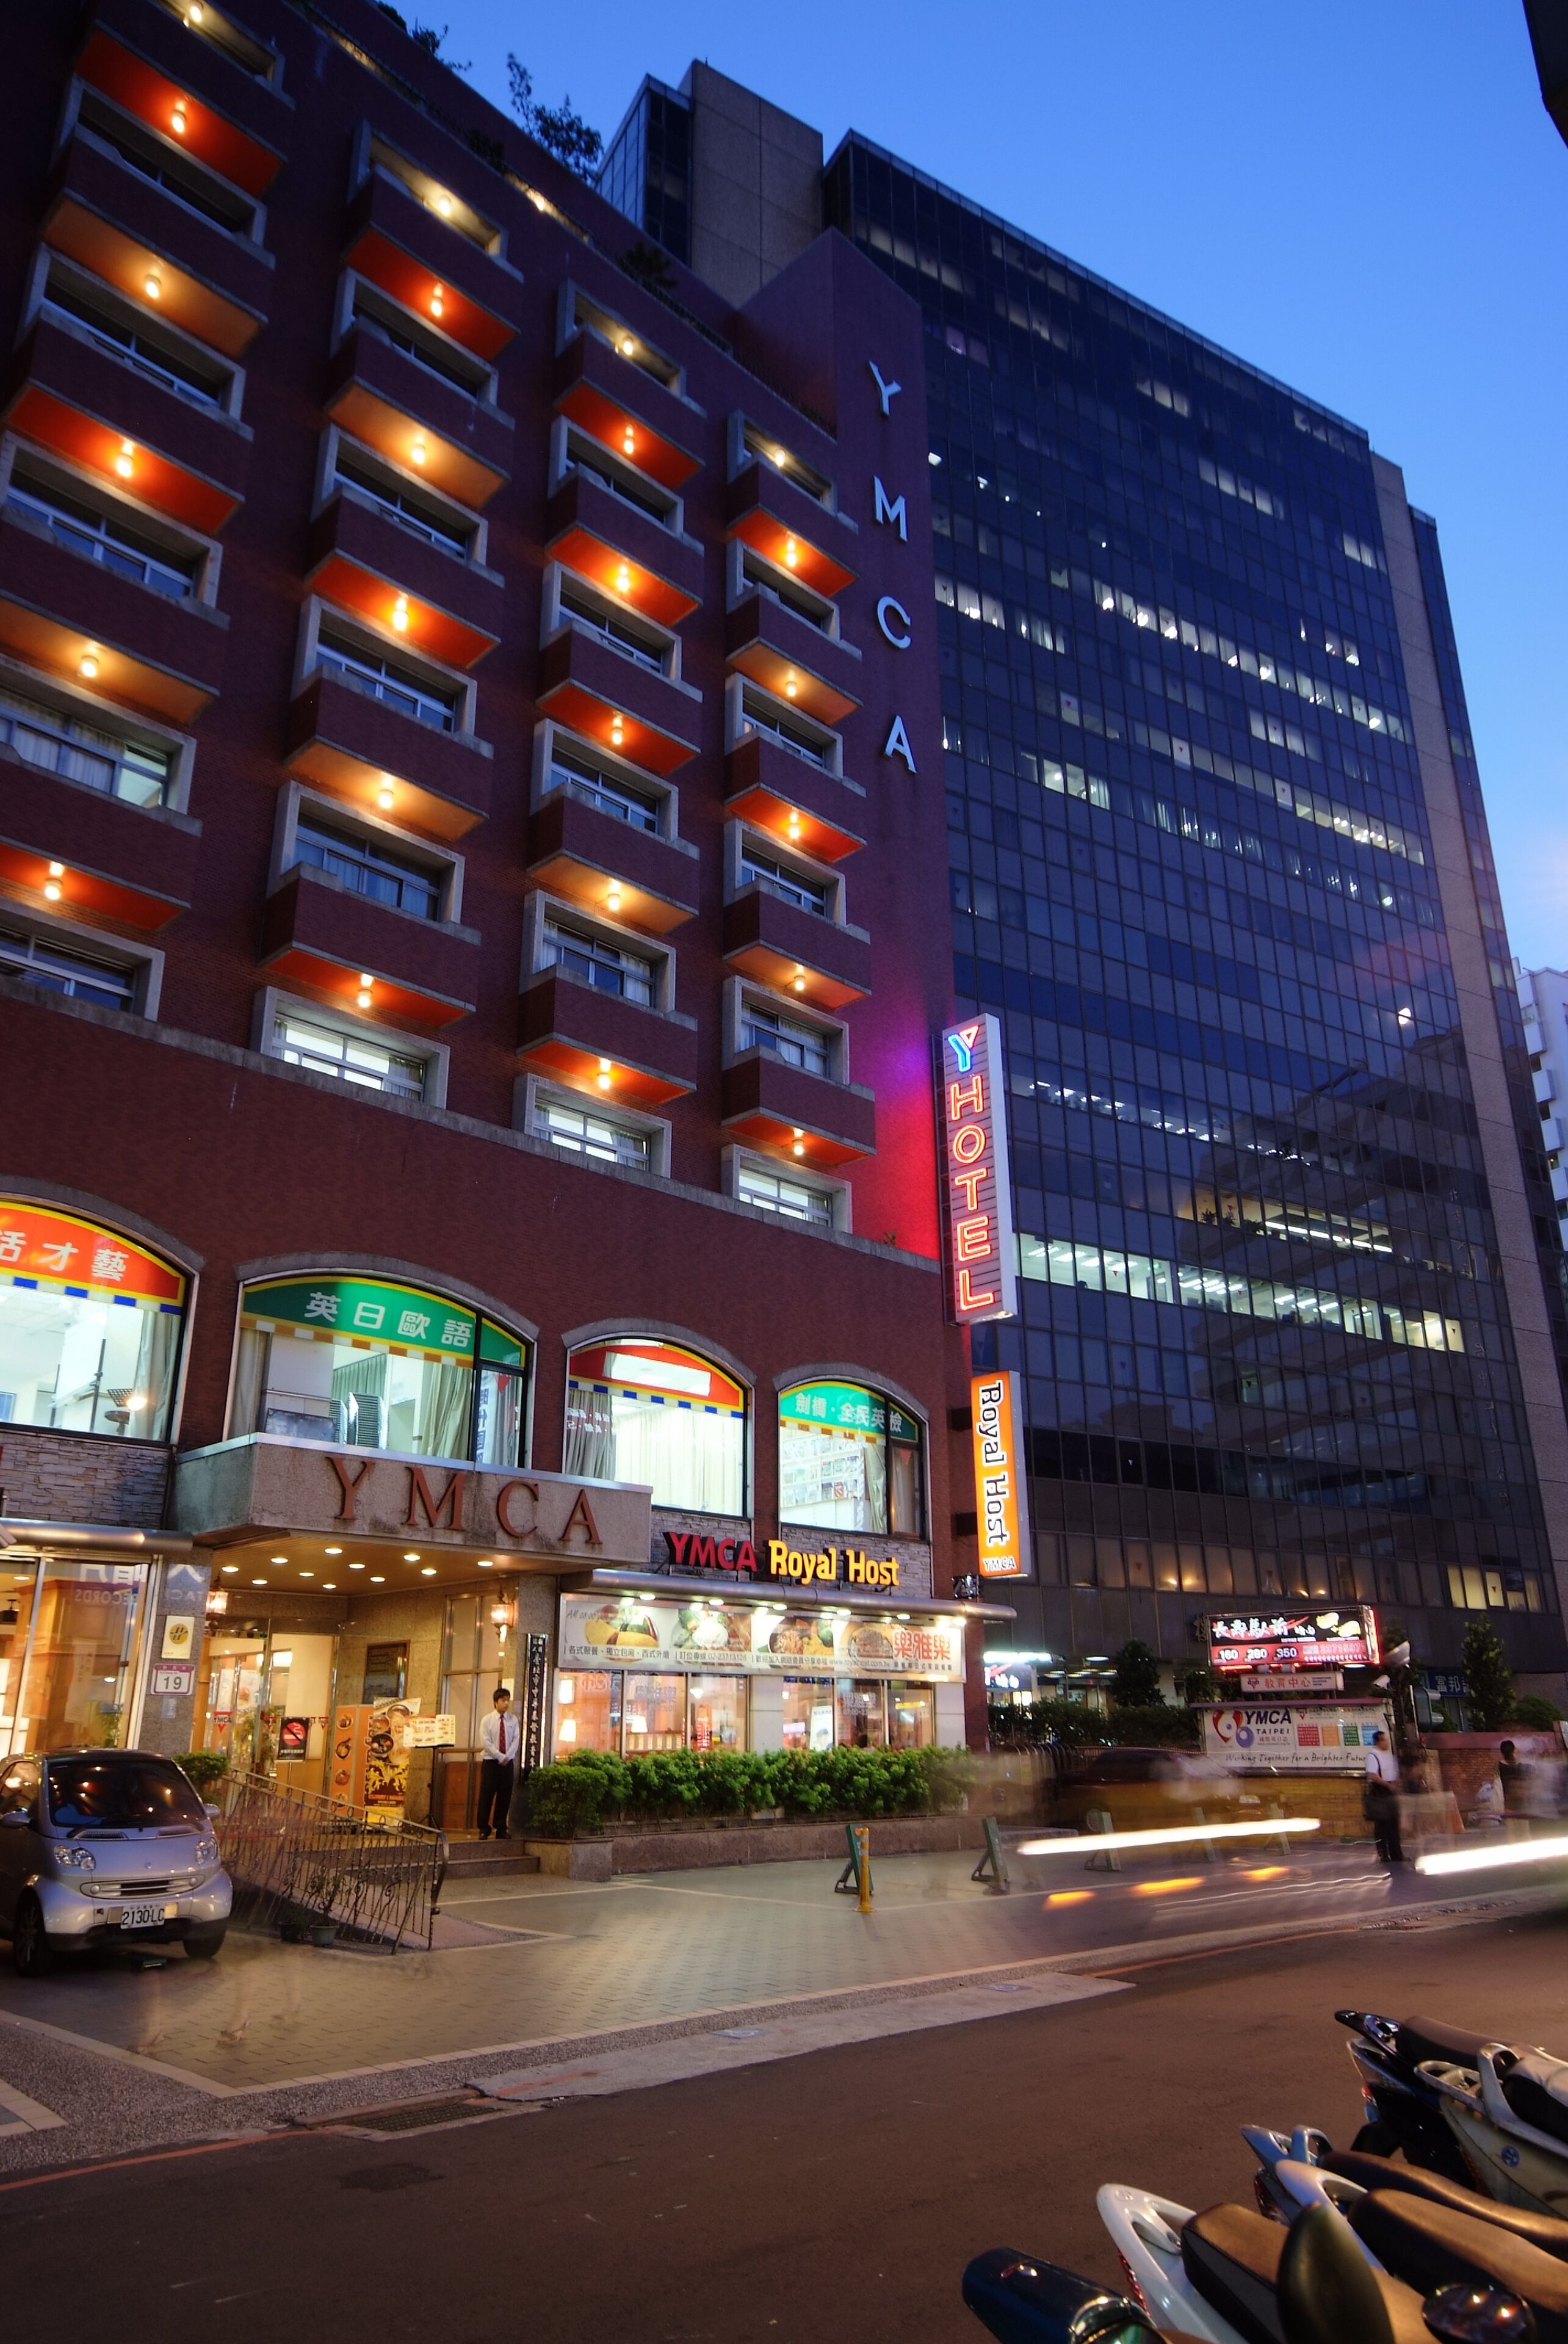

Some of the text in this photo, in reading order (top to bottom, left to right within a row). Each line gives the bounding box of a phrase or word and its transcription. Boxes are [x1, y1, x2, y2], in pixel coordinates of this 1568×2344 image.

[869, 360, 917, 774] YMCA
[948, 1026, 994, 1311] Y HOTEL
[304, 1292, 474, 1348] 英日歐語
[977, 1381, 1009, 1546] Royal Host
[325, 1456, 603, 1544] YMCA
[665, 1532, 899, 1586] YMCA Royal Host
[983, 1557, 1016, 1572] YMCA
[893, 1630, 952, 1660] 樂雅樂
[164, 1676, 182, 1690] 19
[1245, 1710, 1292, 1725] YMCA
[1226, 1753, 1257, 1763] Working
[1259, 1753, 1289, 1764] Together
[1290, 1752, 1302, 1764] for
[1312, 1753, 1343, 1766] Brighter
[1345, 1754, 1367, 1762] Futur
